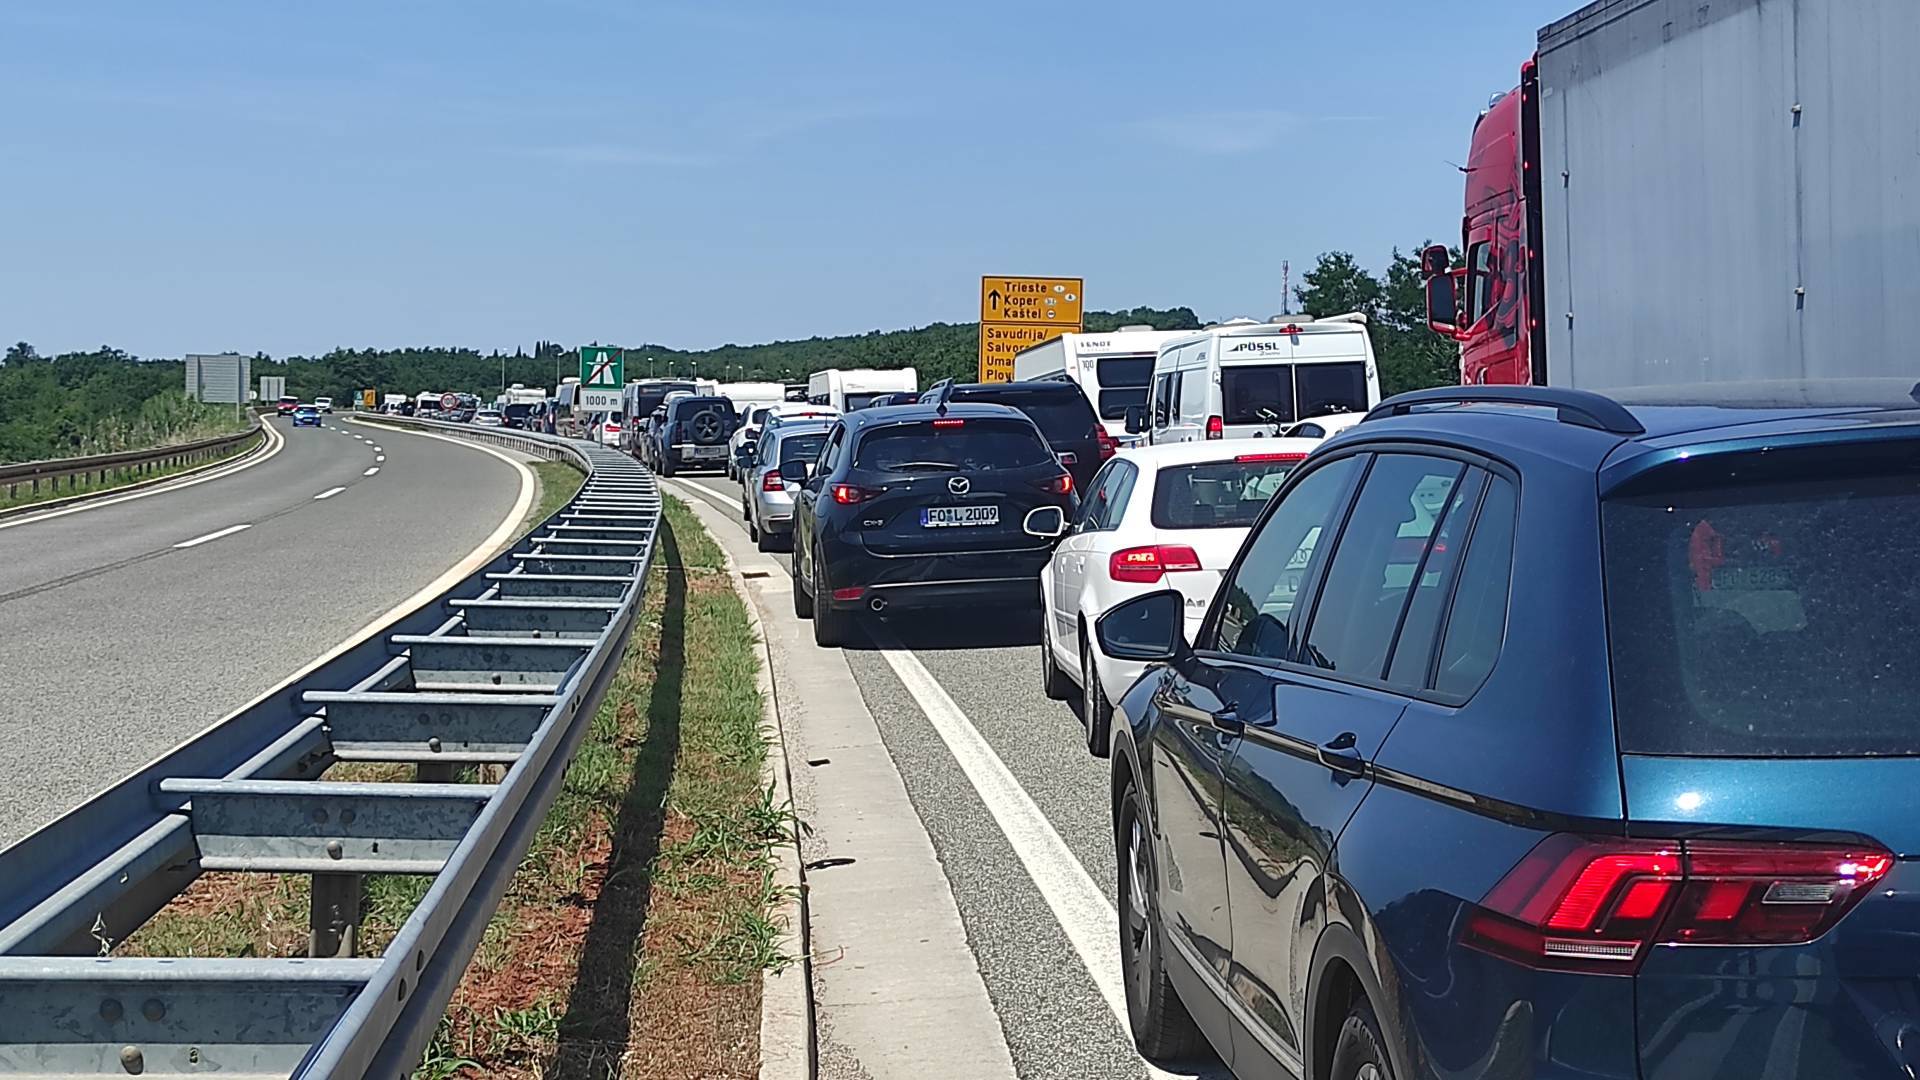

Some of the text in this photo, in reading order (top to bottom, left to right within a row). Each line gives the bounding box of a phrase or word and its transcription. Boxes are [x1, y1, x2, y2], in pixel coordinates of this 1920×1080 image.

[1004, 281, 1047, 293] Trieste
[1004, 294, 1039, 307] Koper
[1003, 307, 1041, 319] Kaštel
[986, 355, 1015, 367] Uma
[585, 395, 606, 405] 1000
[929, 507, 997, 522] FO L 2009
